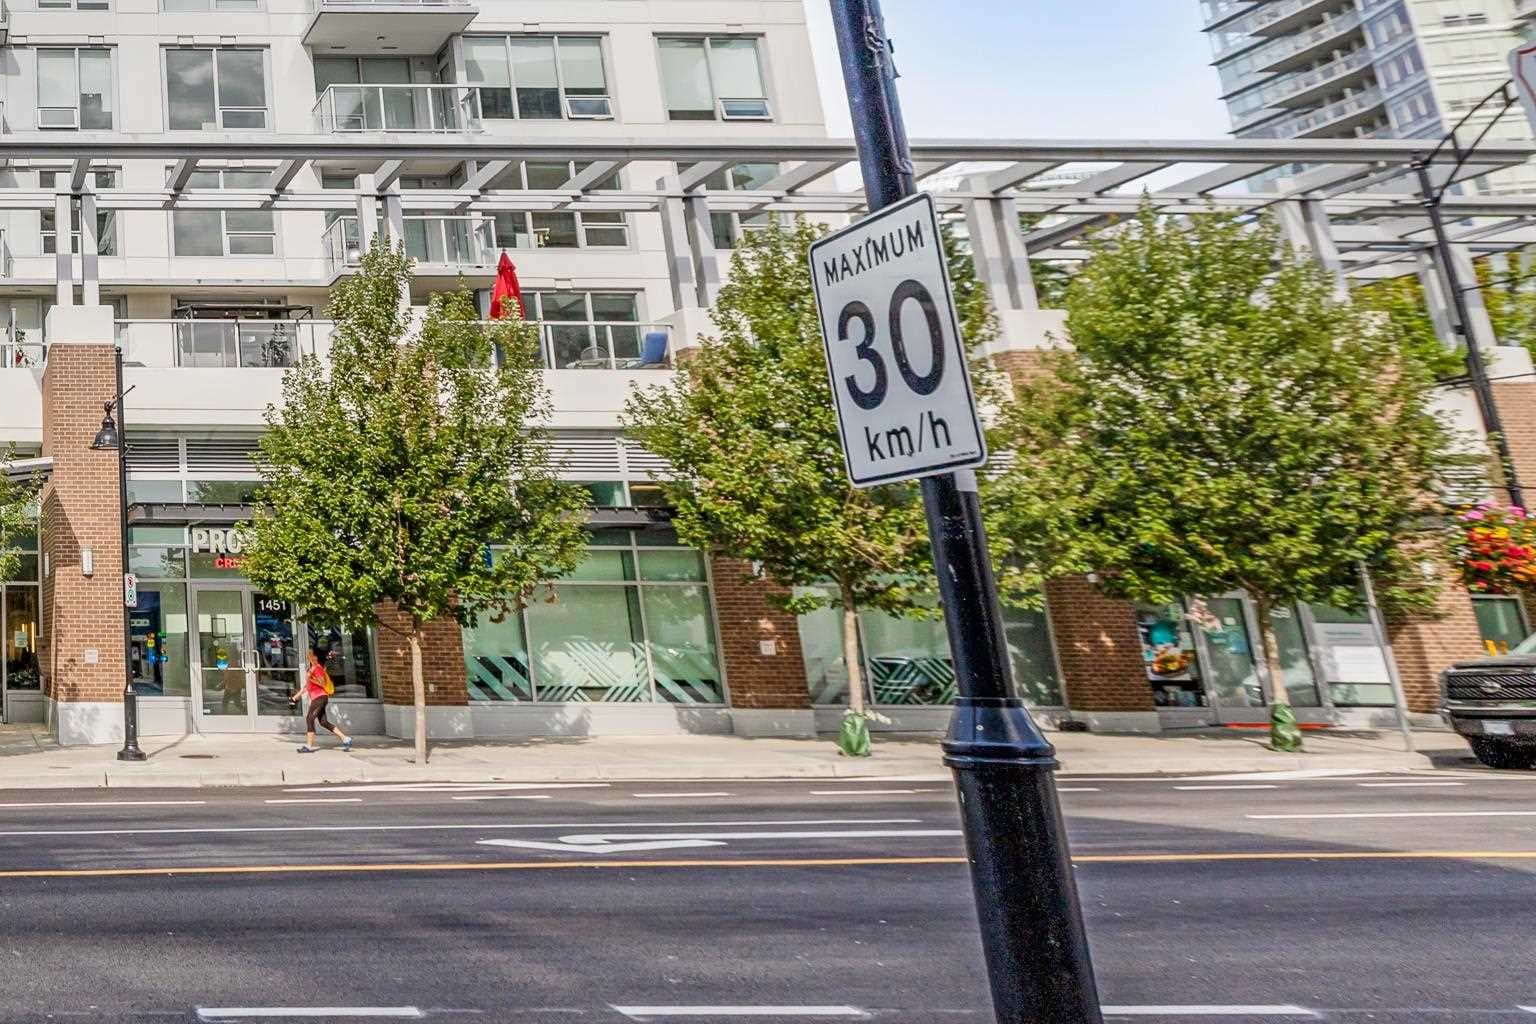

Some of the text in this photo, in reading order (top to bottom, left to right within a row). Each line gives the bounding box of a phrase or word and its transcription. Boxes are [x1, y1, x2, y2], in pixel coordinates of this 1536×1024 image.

[823, 219, 925, 287] MAXIMUM
[838, 279, 946, 410] 30
[864, 410, 953, 462] km/h
[258, 598, 287, 611] 1451
